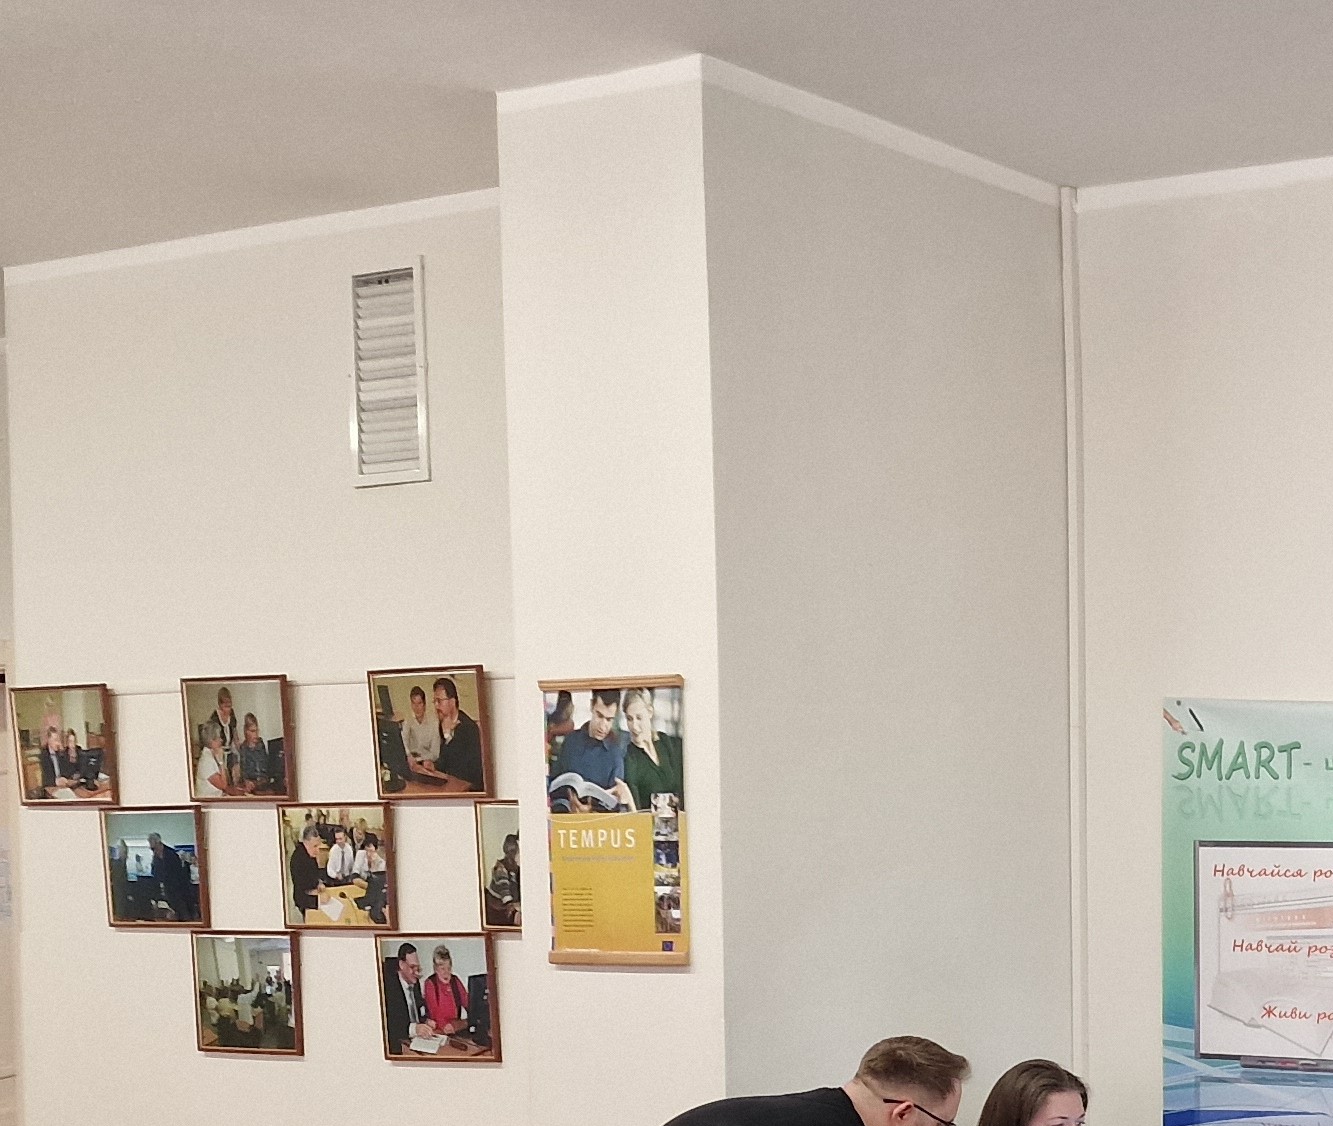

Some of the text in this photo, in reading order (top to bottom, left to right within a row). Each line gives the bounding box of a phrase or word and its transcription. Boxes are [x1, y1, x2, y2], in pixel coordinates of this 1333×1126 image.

[558, 828, 636, 849] TEMPUS
[1213, 863, 1308, 879] Навчайся
[1232, 939, 1303, 954] Навчай
[1260, 1005, 1312, 1020] Живи
